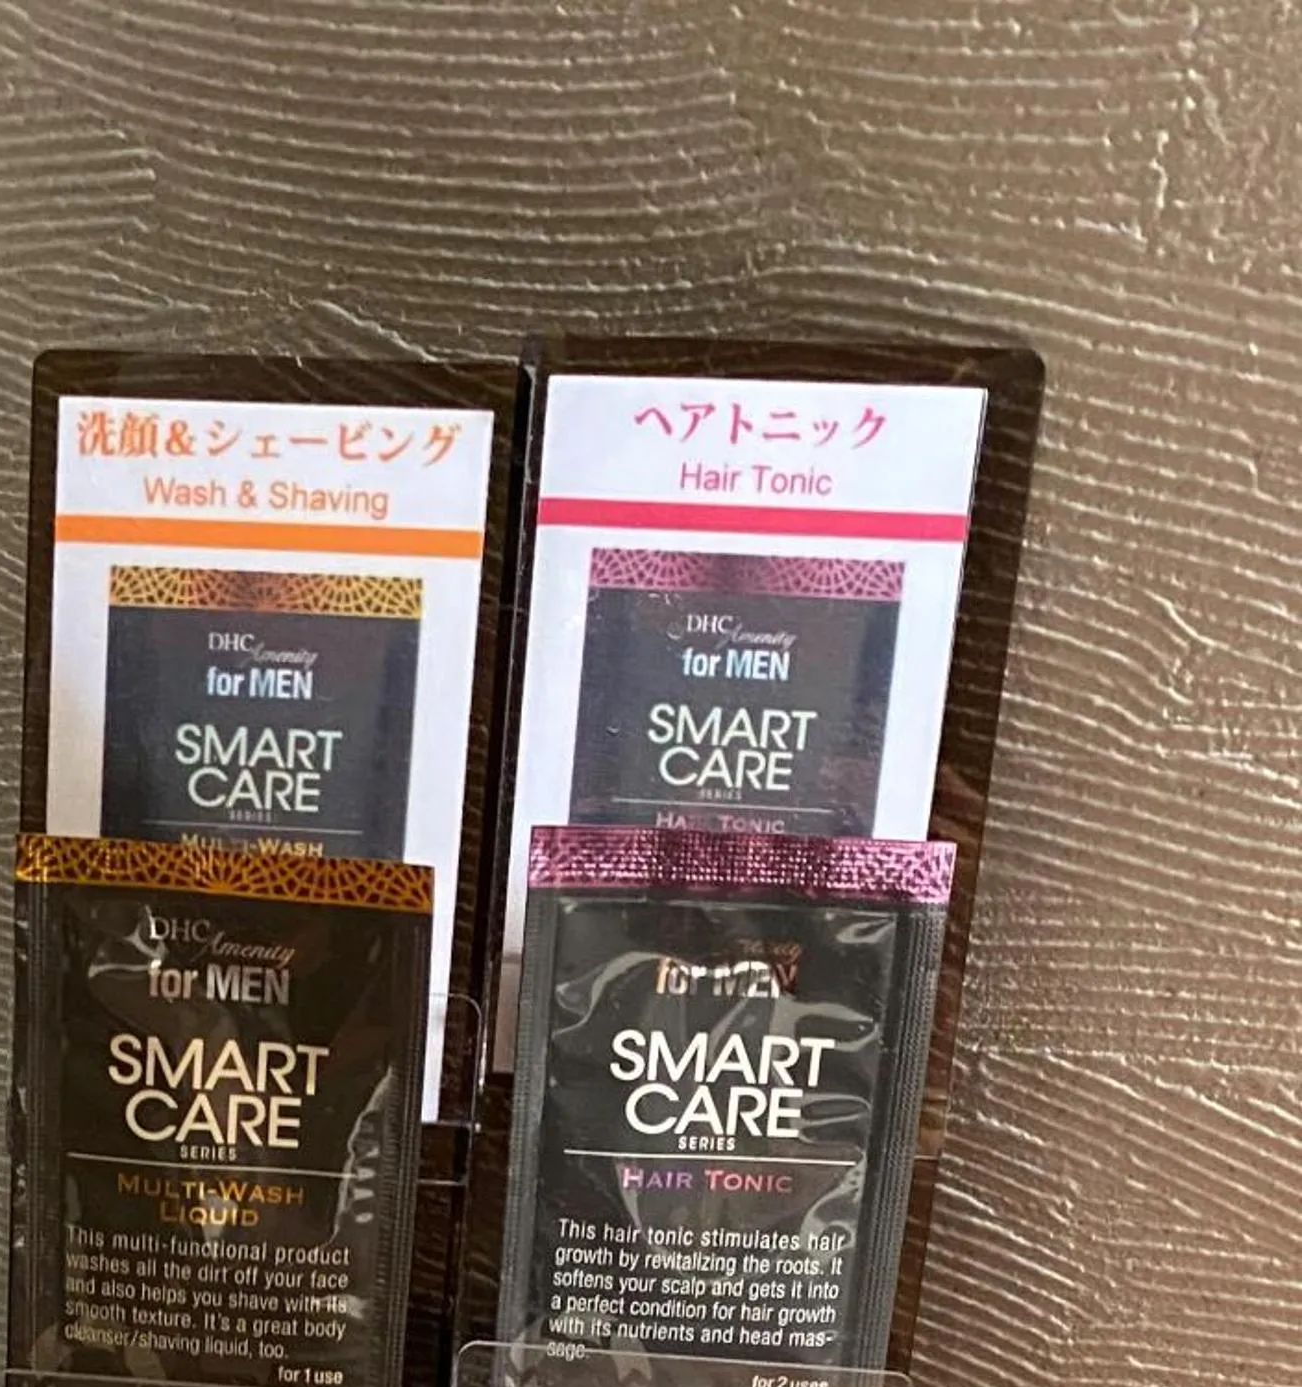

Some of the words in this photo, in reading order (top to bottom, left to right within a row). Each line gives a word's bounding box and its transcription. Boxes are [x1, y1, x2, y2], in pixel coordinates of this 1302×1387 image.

[634, 402, 886, 449] ヘアトニック
[144, 477, 226, 506] Wash
[237, 481, 257, 507] &
[268, 483, 388, 520] Shaving
[680, 462, 741, 492] Hair
[753, 465, 833, 495] Tonic
[207, 667, 245, 697] for
[249, 668, 313, 699] MEN
[681, 647, 721, 677] for
[726, 649, 789, 681] MEN
[175, 723, 342, 771] SMART
[647, 703, 817, 750] SMART
[187, 768, 320, 812] CARE
[659, 747, 793, 791] CARE
[150, 962, 197, 998] for
[207, 964, 289, 1005] MEN
[108, 1034, 329, 1096] SMART
[610, 1029, 836, 1087] SMART
[126, 1090, 301, 1149] CARE
[625, 1083, 803, 1139] CARE
[678, 1136, 736, 1151] SERIES
[118, 1172, 304, 1204] MULTI-WASH
[622, 1168, 693, 1189] HAIR
[704, 1169, 793, 1193] TONIC
[160, 1202, 259, 1227] LIQUID
[559, 1218, 596, 1240] This
[604, 1223, 639, 1243] hair
[648, 1226, 693, 1245] tonic
[701, 1228, 799, 1250] stimulates
[808, 1233, 846, 1251] hair
[66, 1252, 129, 1274] washes
[137, 1257, 156, 1276] all
[164, 1260, 191, 1280] the
[198, 1264, 229, 1284] dirt
[235, 1266, 258, 1286] off
[265, 1272, 304, 1291] your
[311, 1269, 348, 1290] face
[552, 1272, 613, 1290] softens
[619, 1276, 656, 1294] your
[661, 1278, 705, 1298] scalp
[711, 1279, 743, 1297] and
[749, 1280, 786, 1301] gets
[791, 1280, 802, 1298] it
[808, 1281, 839, 1299] into
